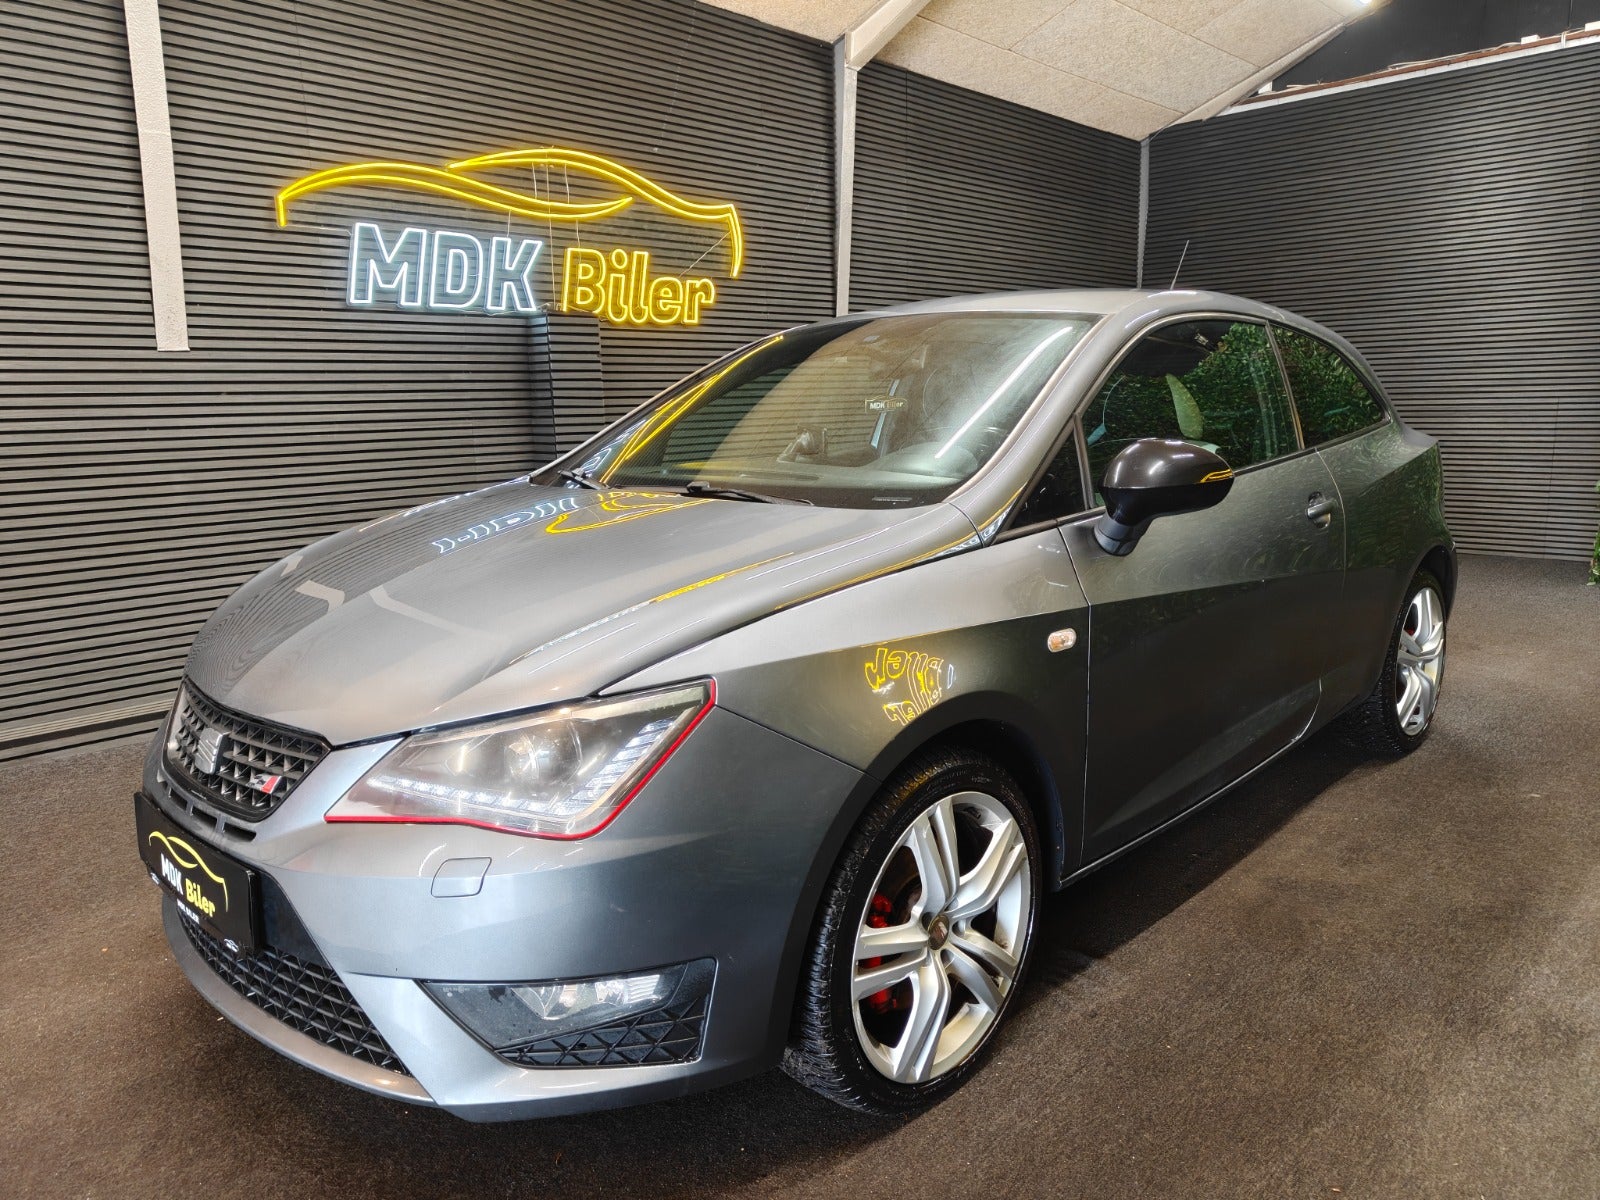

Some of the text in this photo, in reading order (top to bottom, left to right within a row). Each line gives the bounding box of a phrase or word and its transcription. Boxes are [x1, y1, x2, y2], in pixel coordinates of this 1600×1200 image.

[349, 222, 715, 324] MDK Biler
[869, 402, 885, 410] MDK
[160, 852, 184, 896] MDK
[185, 877, 216, 918] Biler
